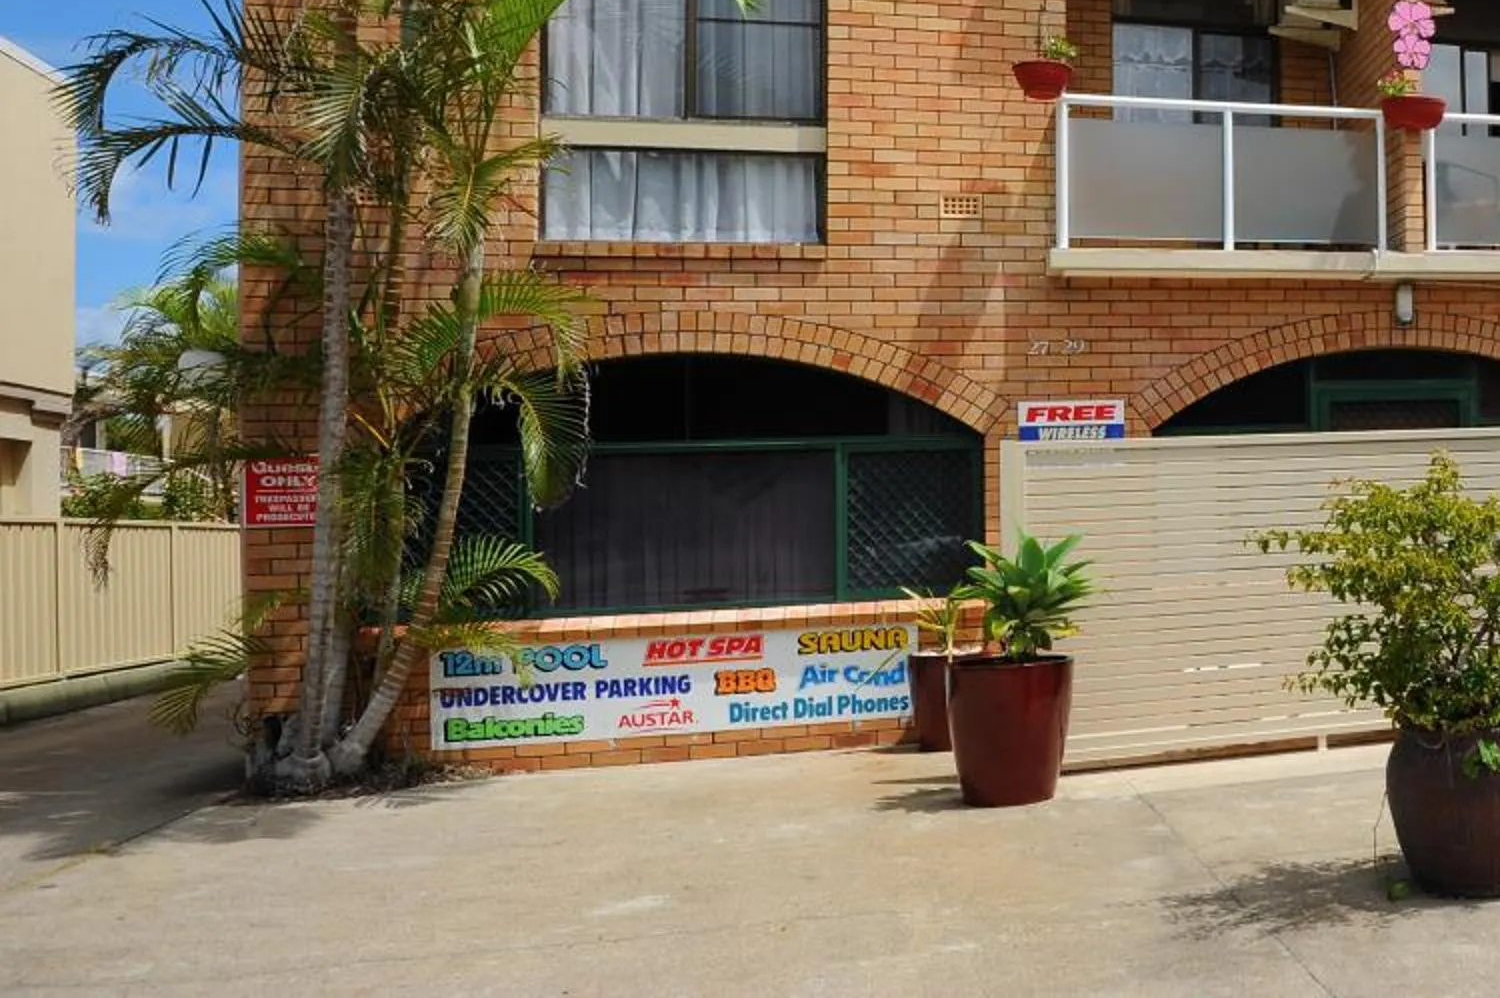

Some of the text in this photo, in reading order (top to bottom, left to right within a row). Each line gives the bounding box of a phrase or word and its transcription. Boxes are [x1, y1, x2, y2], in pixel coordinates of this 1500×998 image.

[1025, 404, 1117, 423] FREE
[1038, 424, 1107, 441] WIRELESS
[255, 513, 317, 523] PROSECUTE
[645, 634, 764, 661] HOT SPA
[797, 627, 910, 656] SAUNA
[714, 667, 776, 696] BBQ
[798, 664, 838, 691] Air
[439, 674, 692, 709] UNDERCOVER PARKING
[618, 709, 694, 729] AUSTAR
[729, 693, 910, 724] Direct Dial Phones
[444, 711, 585, 742] Balconies
